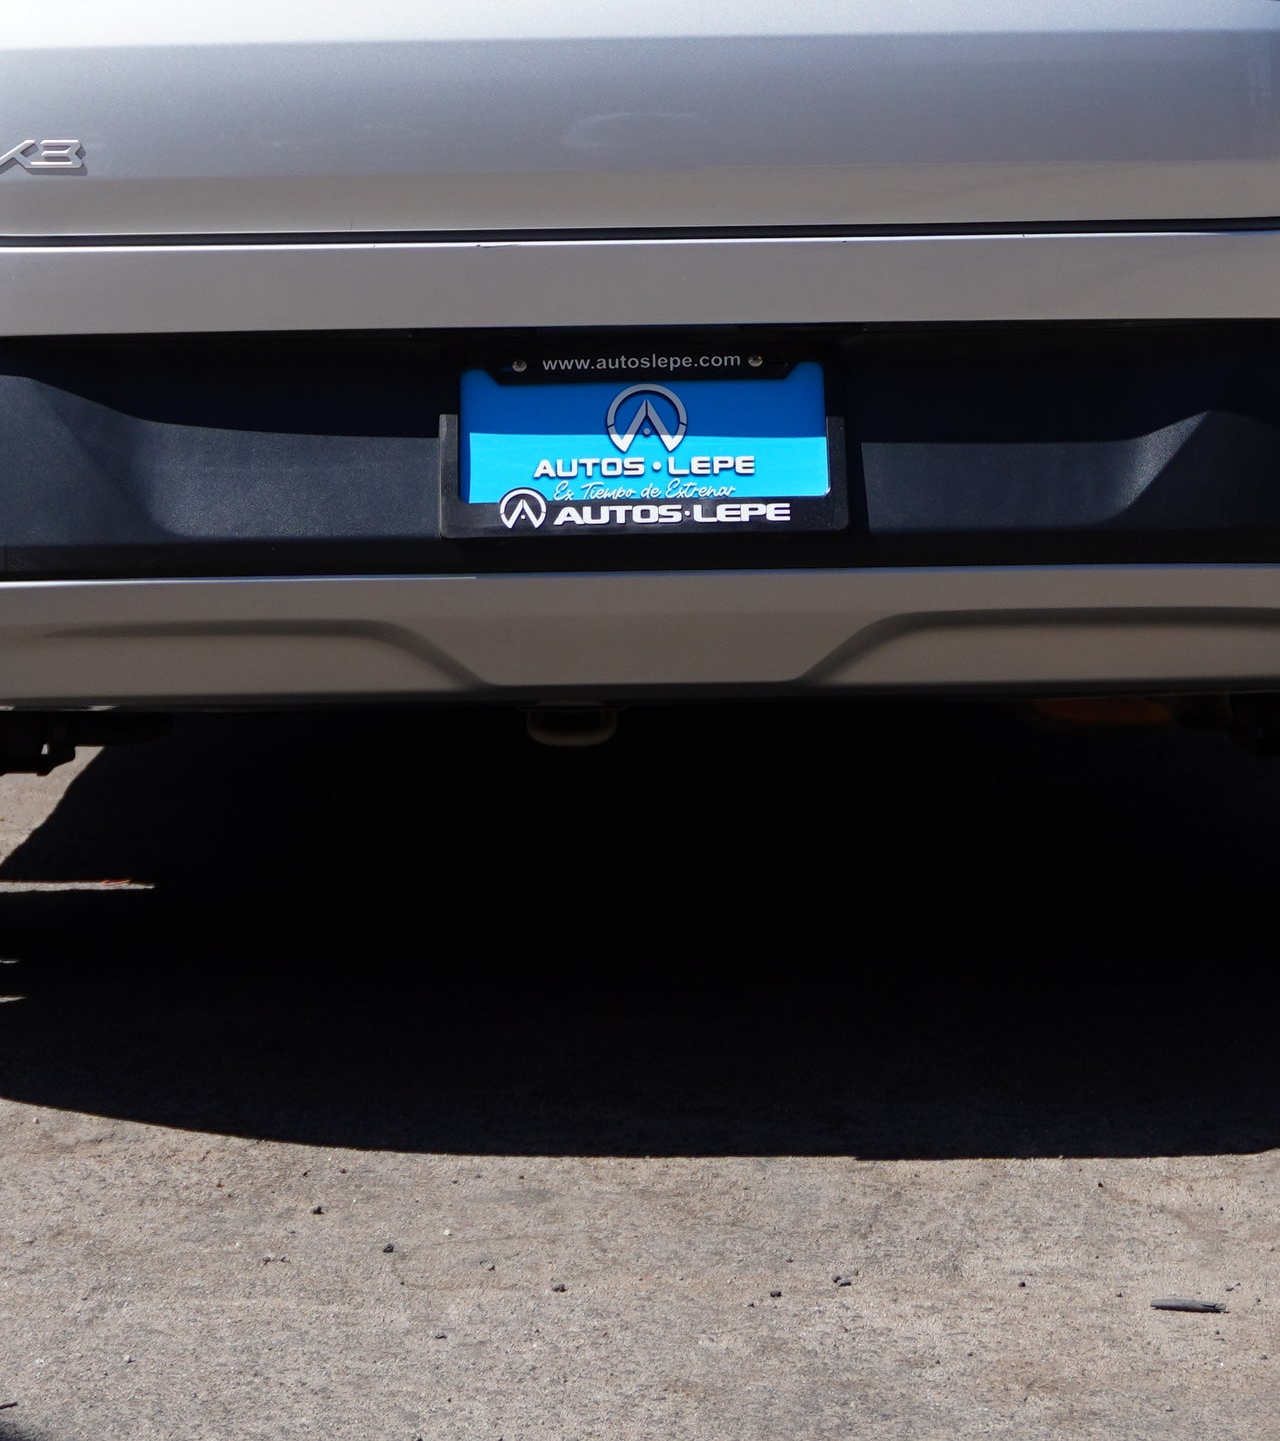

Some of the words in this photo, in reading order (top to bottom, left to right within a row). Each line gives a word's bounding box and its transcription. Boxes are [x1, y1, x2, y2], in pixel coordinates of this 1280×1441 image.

[542, 353, 741, 372] www.autoslepe.com
[533, 456, 646, 478] AUTOS
[667, 454, 756, 475] LEPE
[580, 480, 636, 500] Tiempo
[640, 483, 663, 499] de
[665, 478, 737, 500] Estrenar
